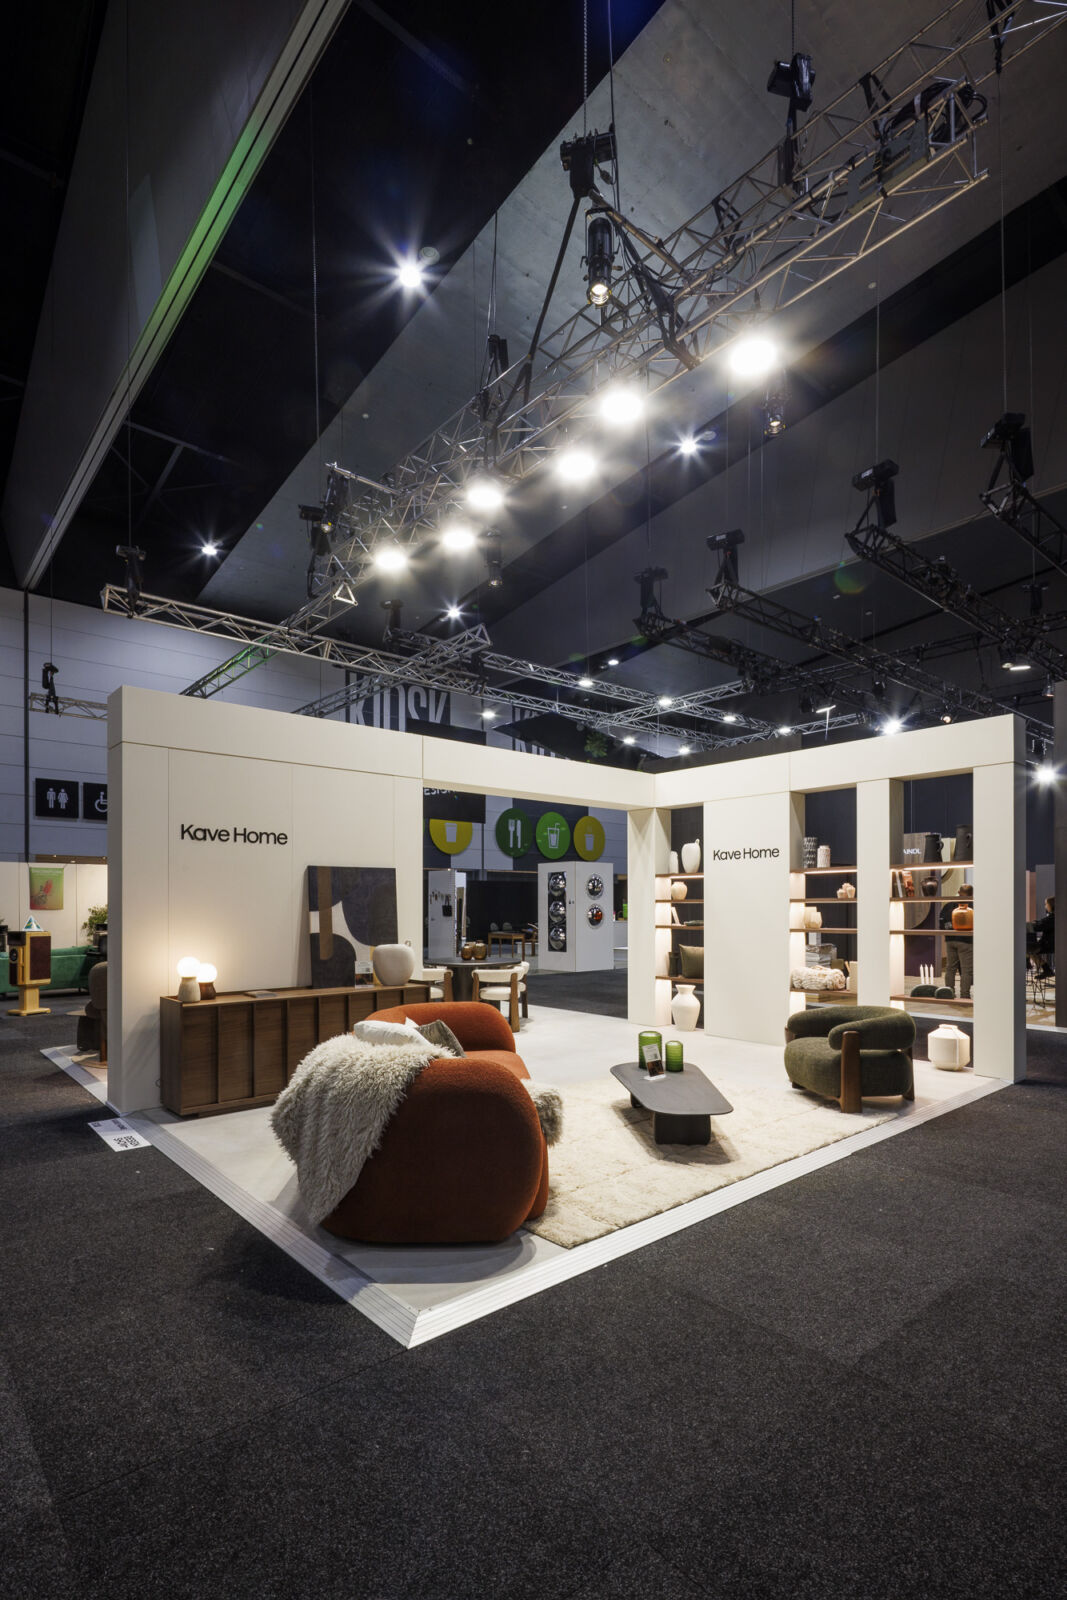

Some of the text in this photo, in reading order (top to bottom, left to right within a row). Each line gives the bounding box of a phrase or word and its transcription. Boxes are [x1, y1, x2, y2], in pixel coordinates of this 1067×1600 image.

[180, 823, 288, 845] Kave Home
[713, 847, 780, 861] Kave Home
